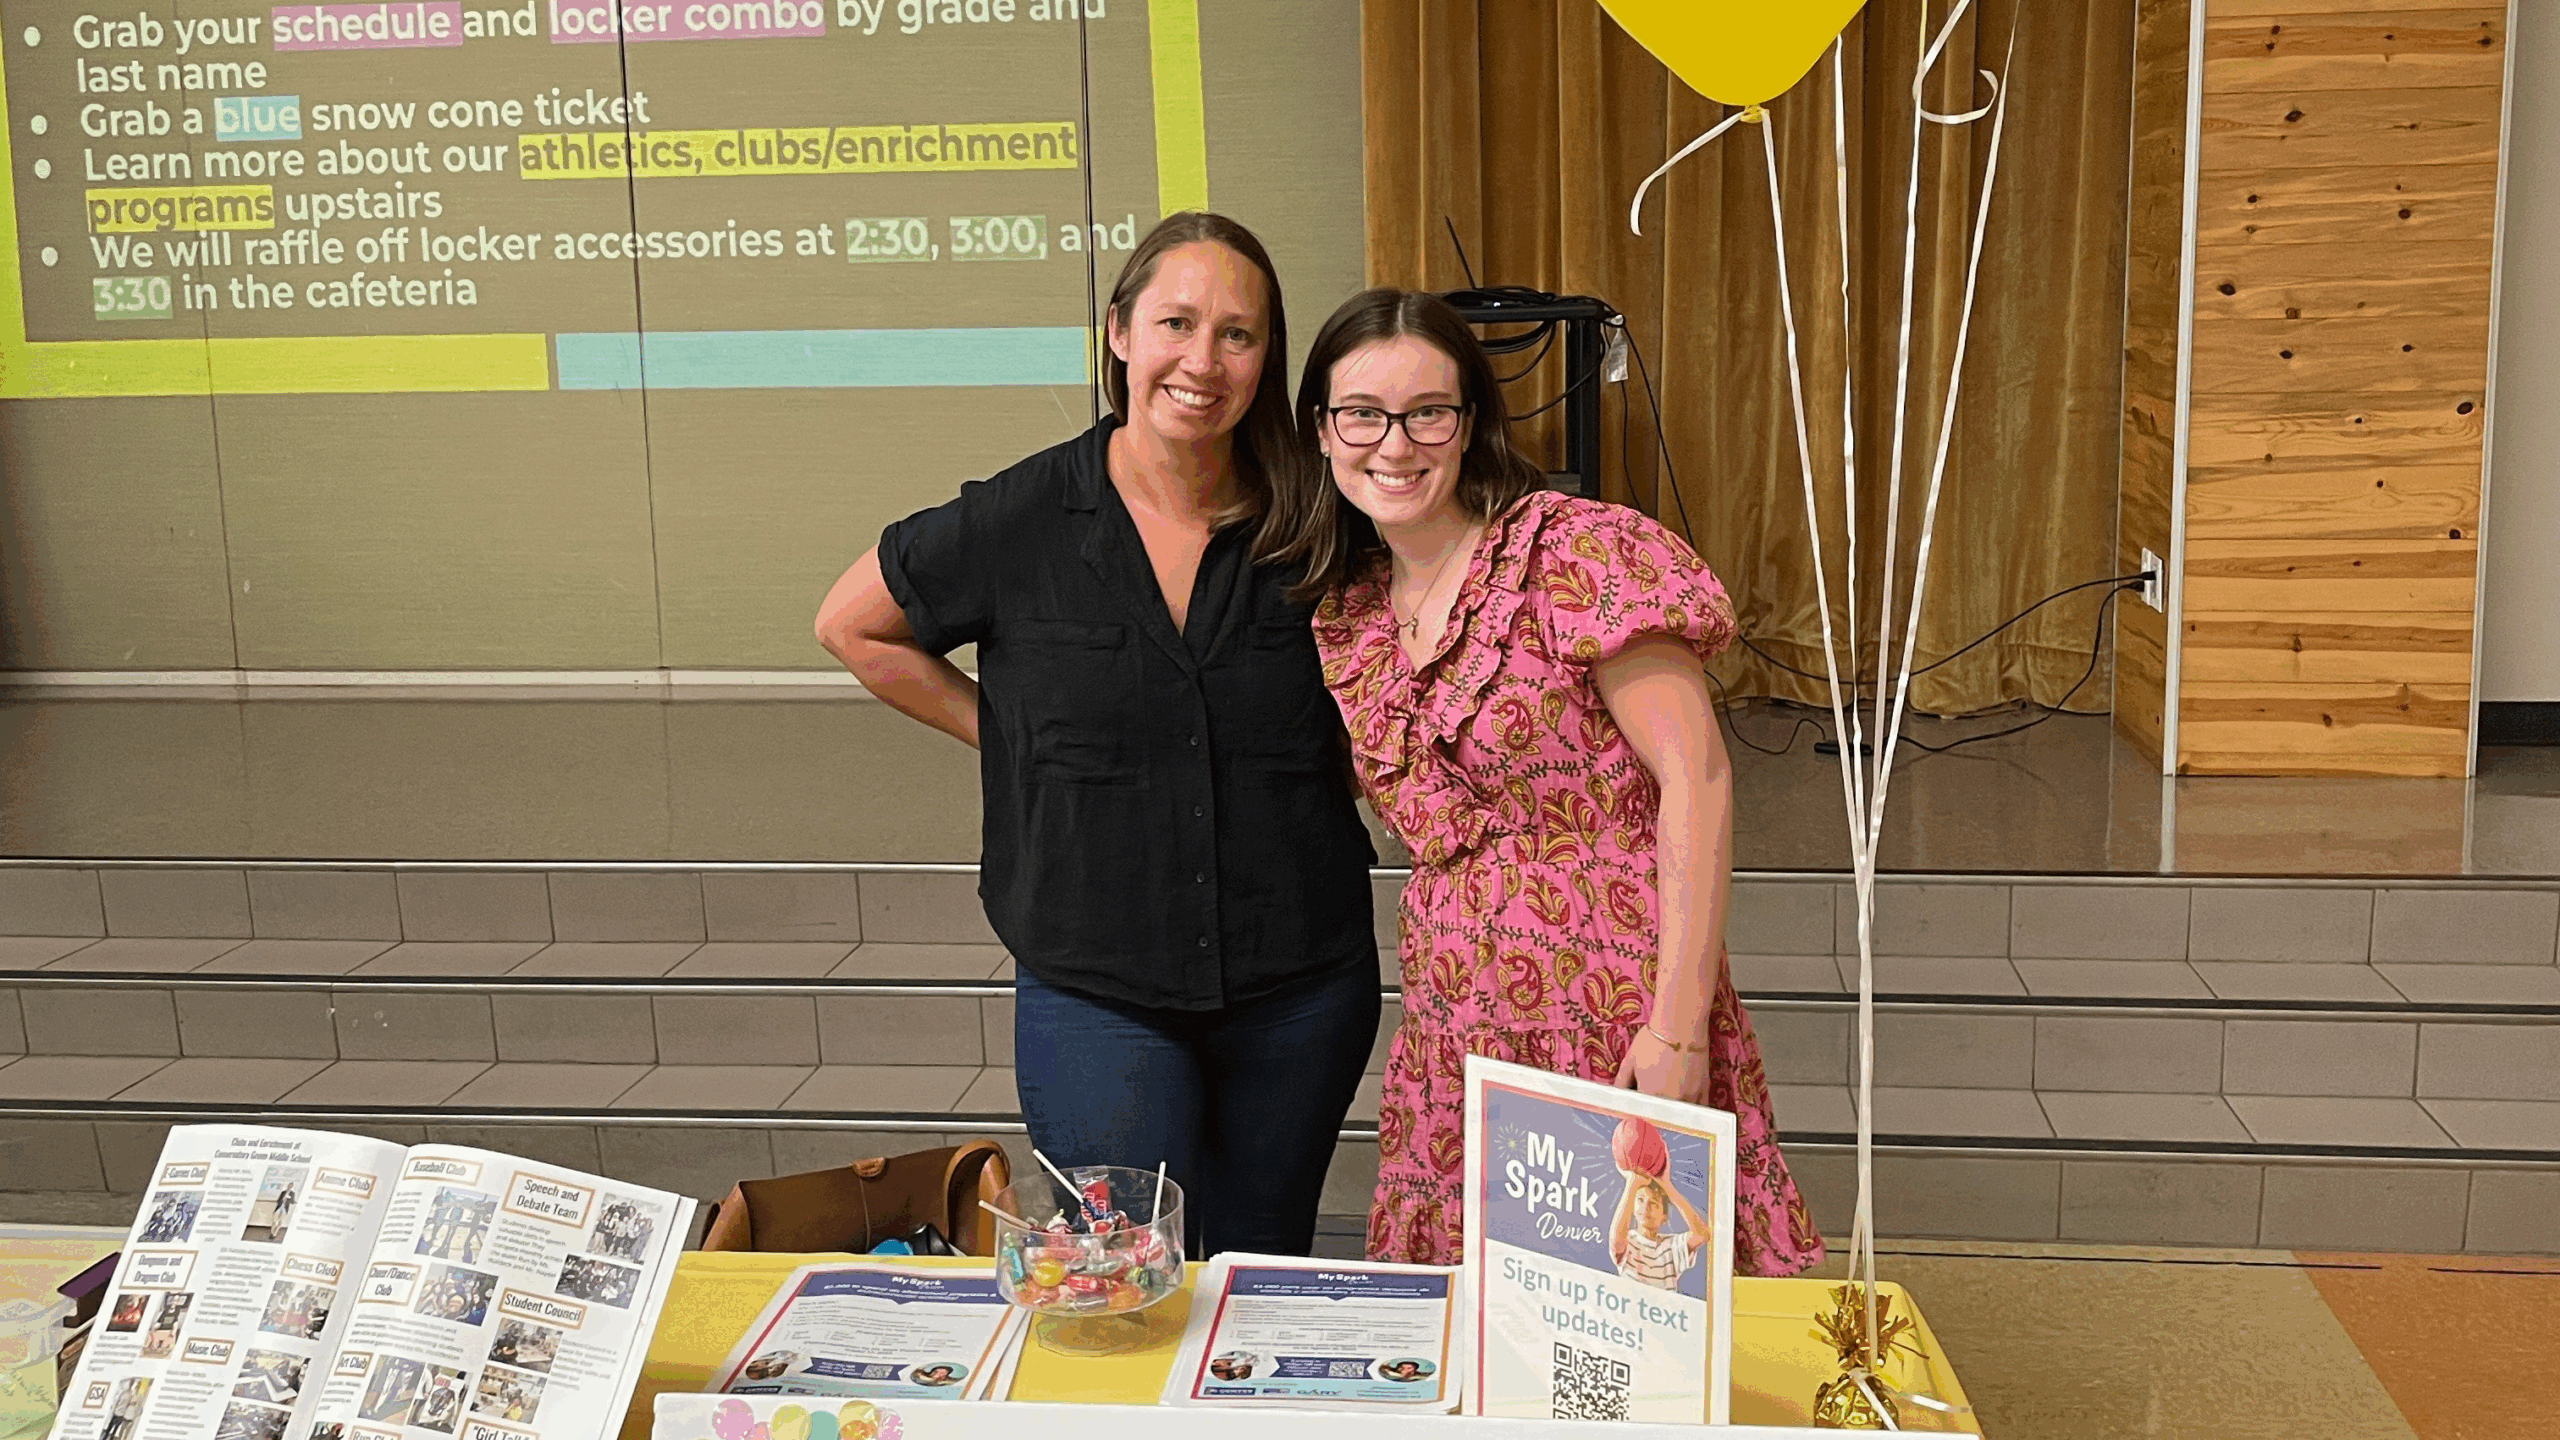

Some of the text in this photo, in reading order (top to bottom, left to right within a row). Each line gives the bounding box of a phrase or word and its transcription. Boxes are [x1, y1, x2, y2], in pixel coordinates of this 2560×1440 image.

[73, 0, 1106, 55] Grab your schedule and locker combo by grade and
[77, 58, 267, 94] last name
[80, 88, 650, 138] Grab a blue snow cone ticket
[85, 125, 1075, 182] Learn more about our athletics, clubs/enrichment
[89, 182, 443, 231] programs upstairs
[90, 214, 1136, 269] We will raffle off locker accessories at 2:30, 3:00, and
[94, 270, 477, 313] 3:30 in the cafeteria
[446, 1164, 467, 1176] Club
[1527, 1131, 1575, 1187] My
[348, 1175, 370, 1191] Club
[524, 1179, 580, 1203] Speech and
[1504, 1159, 1598, 1219] Spark
[516, 1194, 579, 1220] Debate Team
[1536, 1211, 1604, 1244] Denver
[169, 1256, 183, 1266] and
[286, 1257, 338, 1278] Chess Club
[160, 1272, 176, 1284] Club
[375, 1283, 392, 1297] Club
[892, 1276, 942, 1287] My Spark
[1318, 1273, 1369, 1282] My Spark
[504, 1293, 582, 1321] Student Council
[1503, 1256, 1689, 1333] Sign up for text
[1541, 1305, 1644, 1351] updates!
[210, 1344, 229, 1357] Club
[350, 1357, 367, 1370] Club
